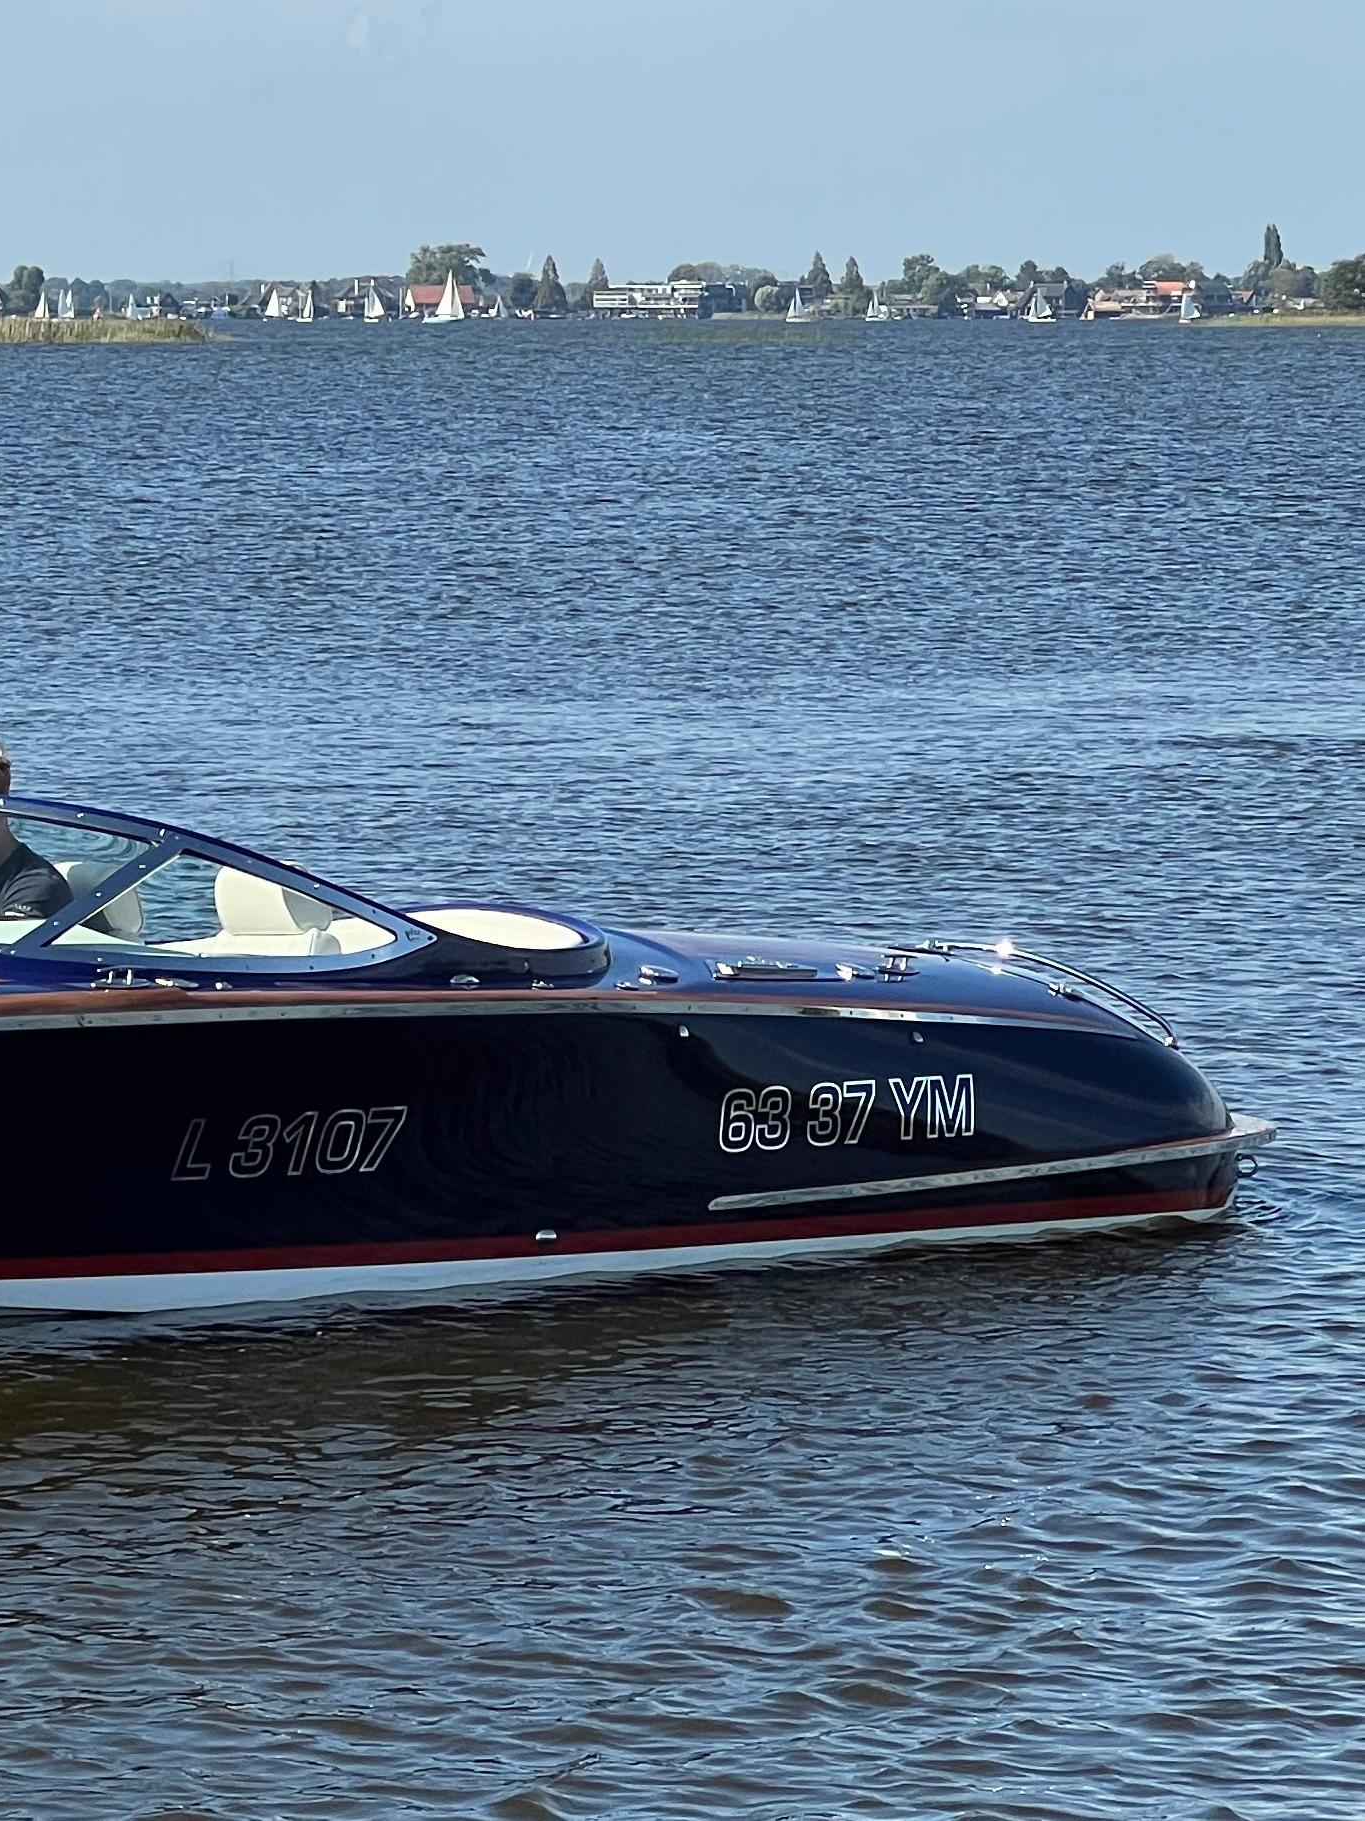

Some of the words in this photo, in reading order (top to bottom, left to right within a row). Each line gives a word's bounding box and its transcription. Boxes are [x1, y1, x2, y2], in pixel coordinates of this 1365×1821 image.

[170, 1118, 211, 1181] L
[229, 1105, 407, 1178] 3107
[719, 1085, 792, 1152] 63
[806, 1079, 876, 1147] 37
[888, 1073, 975, 1140] YM
